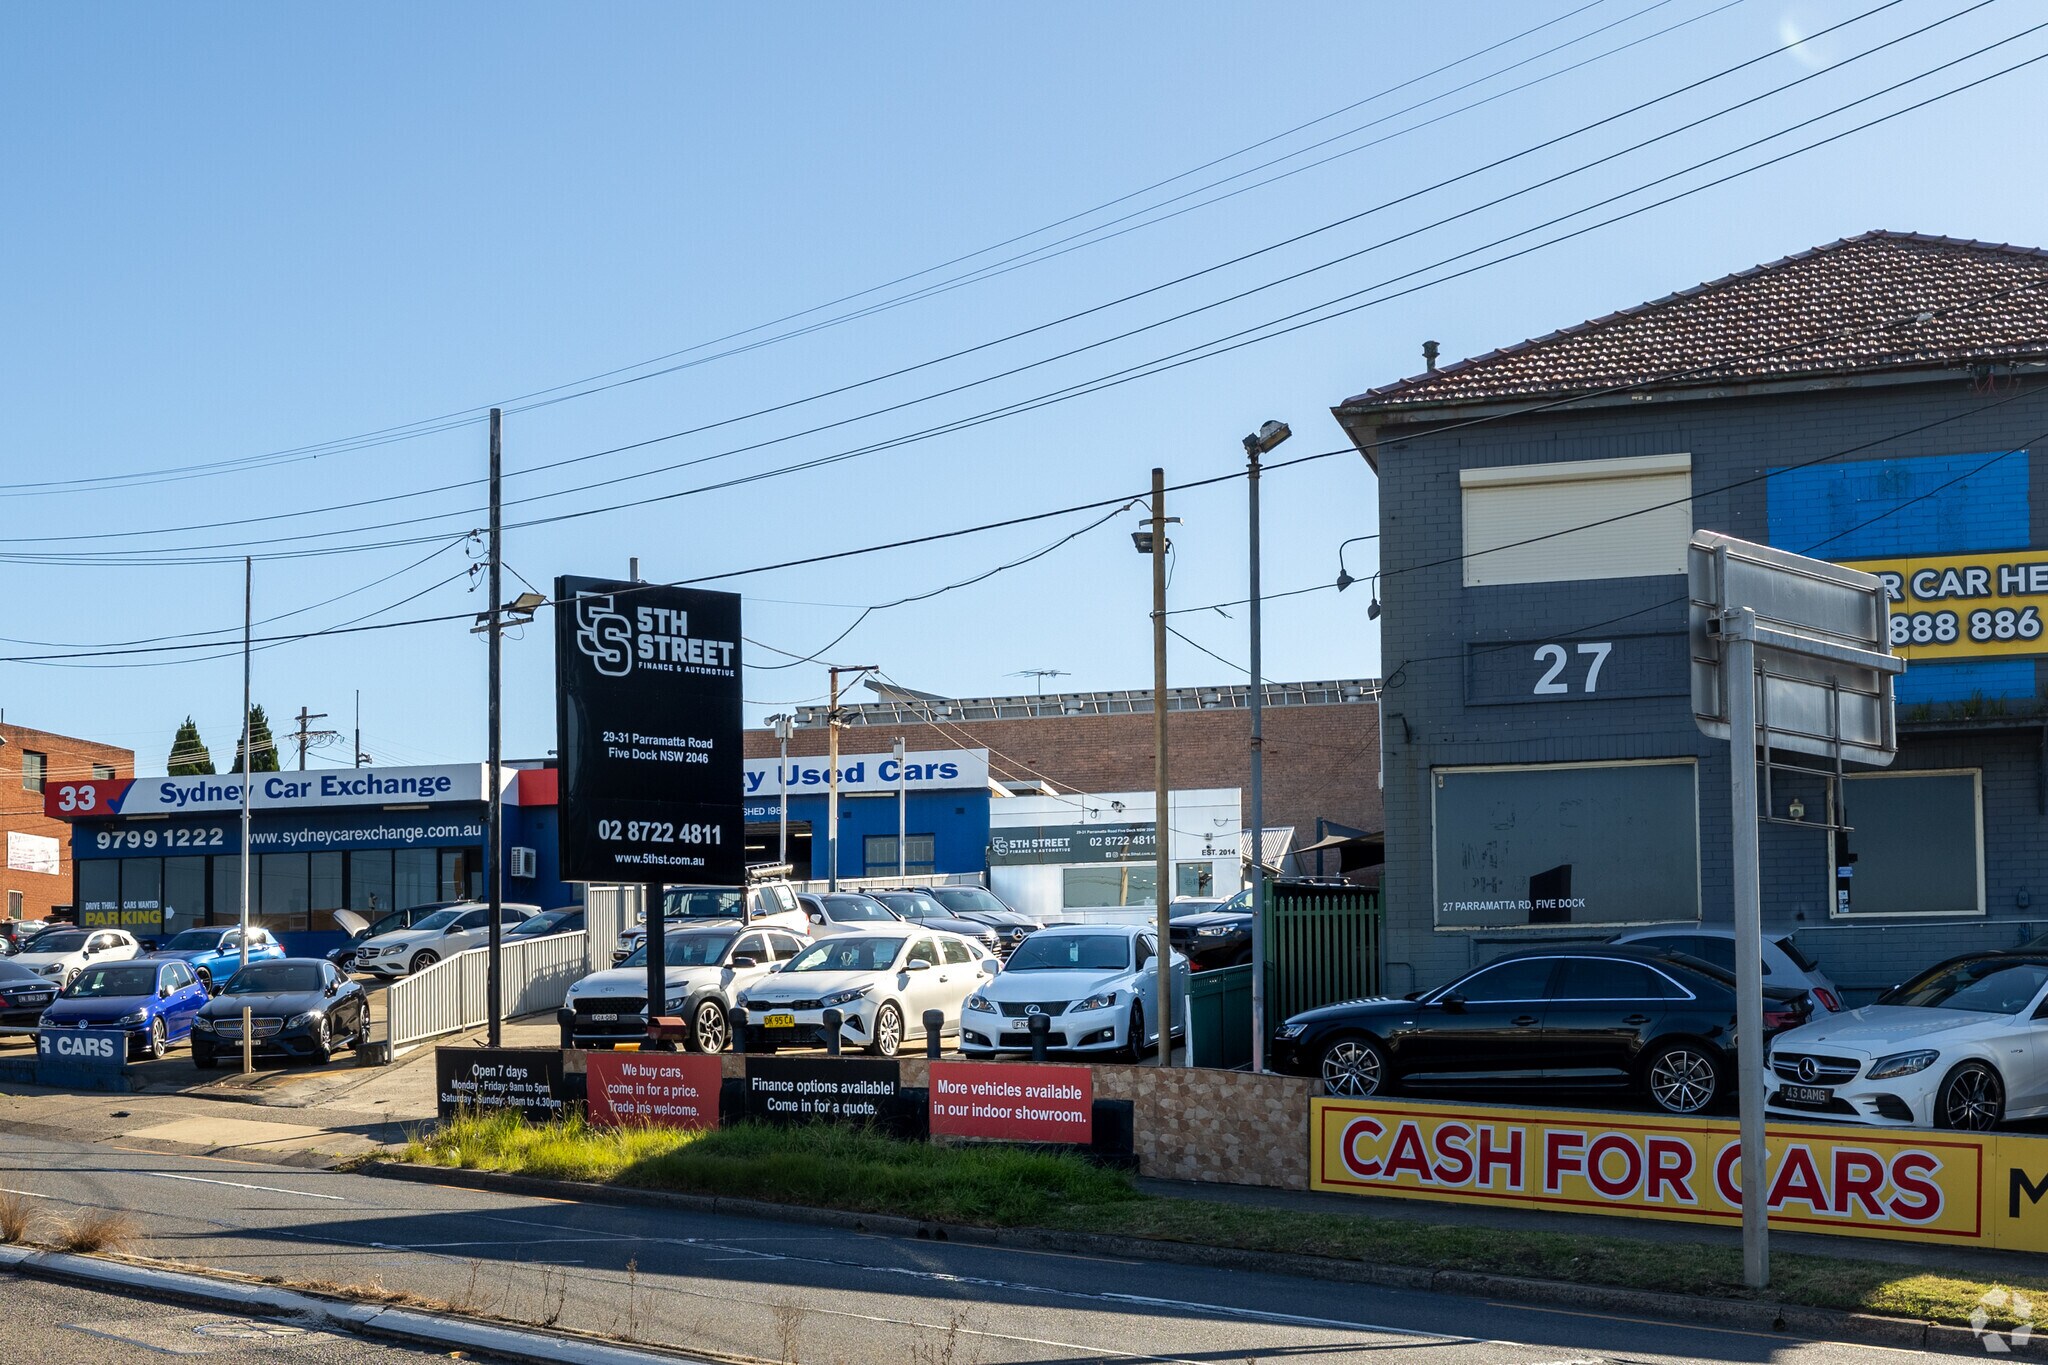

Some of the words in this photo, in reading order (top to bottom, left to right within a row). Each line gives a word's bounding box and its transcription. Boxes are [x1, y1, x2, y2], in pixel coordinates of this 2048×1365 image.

[1912, 569, 1988, 598] CAR
[637, 606, 688, 636] 5TH
[1971, 609, 2040, 640] 886
[638, 633, 734, 667] STREET
[638, 662, 674, 672] FINANCE
[685, 666, 735, 677] AUTOMOTIVE
[1533, 642, 1612, 695] 27
[603, 731, 630, 744] 29-31
[632, 733, 686, 747] Parramatta
[688, 738, 713, 749] Road
[608, 747, 630, 758] Five
[632, 749, 658, 761] Dock
[660, 751, 684, 762] NSW
[686, 753, 708, 764] 2046
[778, 761, 864, 786] Used
[878, 760, 959, 782] Cars
[58, 785, 96, 812] 33
[159, 781, 254, 807] Sydney
[264, 778, 312, 799] Car
[320, 774, 451, 798] Exchange
[96, 830, 158, 850] 9799
[163, 827, 224, 847] 1222
[249, 824, 482, 847] www.sydneycarexchange.com.au
[599, 819, 622, 840] 02
[628, 821, 674, 843] 8722
[679, 823, 721, 845] 4811
[1090, 837, 1102, 846] 02
[1105, 836, 1130, 846] 8722
[1132, 835, 1156, 845] 4811
[1010, 840, 1029, 848] 5TH
[1032, 838, 1070, 848] STREET
[615, 854, 704, 866] www.5thst.com.au
[85, 902, 100, 910] DRIVE
[123, 901, 136, 909] CARS
[138, 900, 158, 909] WANTED
[1443, 902, 1453, 912] 27
[1455, 900, 1516, 911] PARRAMATTA
[1518, 900, 1534, 911] RD,
[1536, 900, 1556, 909] FIVE
[1558, 898, 1586, 908] DOCK
[86, 910, 162, 926] PARKING
[57, 1037, 114, 1058] CARS
[472, 1064, 496, 1079] Open
[498, 1065, 504, 1077] 7
[506, 1066, 528, 1080] days
[622, 1064, 637, 1076] We
[640, 1064, 657, 1080] buy
[660, 1067, 684, 1080] cars,
[452, 1080, 478, 1092] Monday
[484, 1081, 508, 1092] Friday:
[510, 1082, 524, 1092] 9am
[526, 1083, 533, 1092] to
[534, 1083, 550, 1094] 5pm
[608, 1084, 633, 1094] come
[636, 1083, 644, 1095] in
[647, 1083, 661, 1096] for
[664, 1087, 669, 1096] a
[672, 1085, 699, 1099] price.
[752, 1077, 794, 1092] Finance
[797, 1080, 838, 1095] options
[841, 1080, 894, 1095] available!
[938, 1079, 967, 1094] More
[971, 1082, 1022, 1097] vehicles
[1026, 1084, 1082, 1100] available
[1787, 1086, 1798, 1098] 43
[1800, 1088, 1825, 1101] CAMG
[442, 1092, 472, 1105] Saturday
[477, 1095, 505, 1107] Sunday:
[508, 1095, 526, 1106] 10am
[527, 1097, 534, 1106] to
[536, 1097, 561, 1109] 4.30pm
[608, 1100, 634, 1113] Trade
[654, 1102, 700, 1116] welcome.
[767, 1098, 798, 1112] Come
[801, 1099, 811, 1112] in
[814, 1099, 830, 1113] for
[833, 1103, 840, 1114] a
[843, 1101, 877, 1117] quote.
[934, 1101, 944, 1115] in
[948, 1104, 969, 1116] our
[972, 1103, 1012, 1119] indoor
[1015, 1105, 1086, 1123] showroom.
[1340, 1115, 1526, 1192] CASH
[1543, 1128, 1698, 1205] FOR
